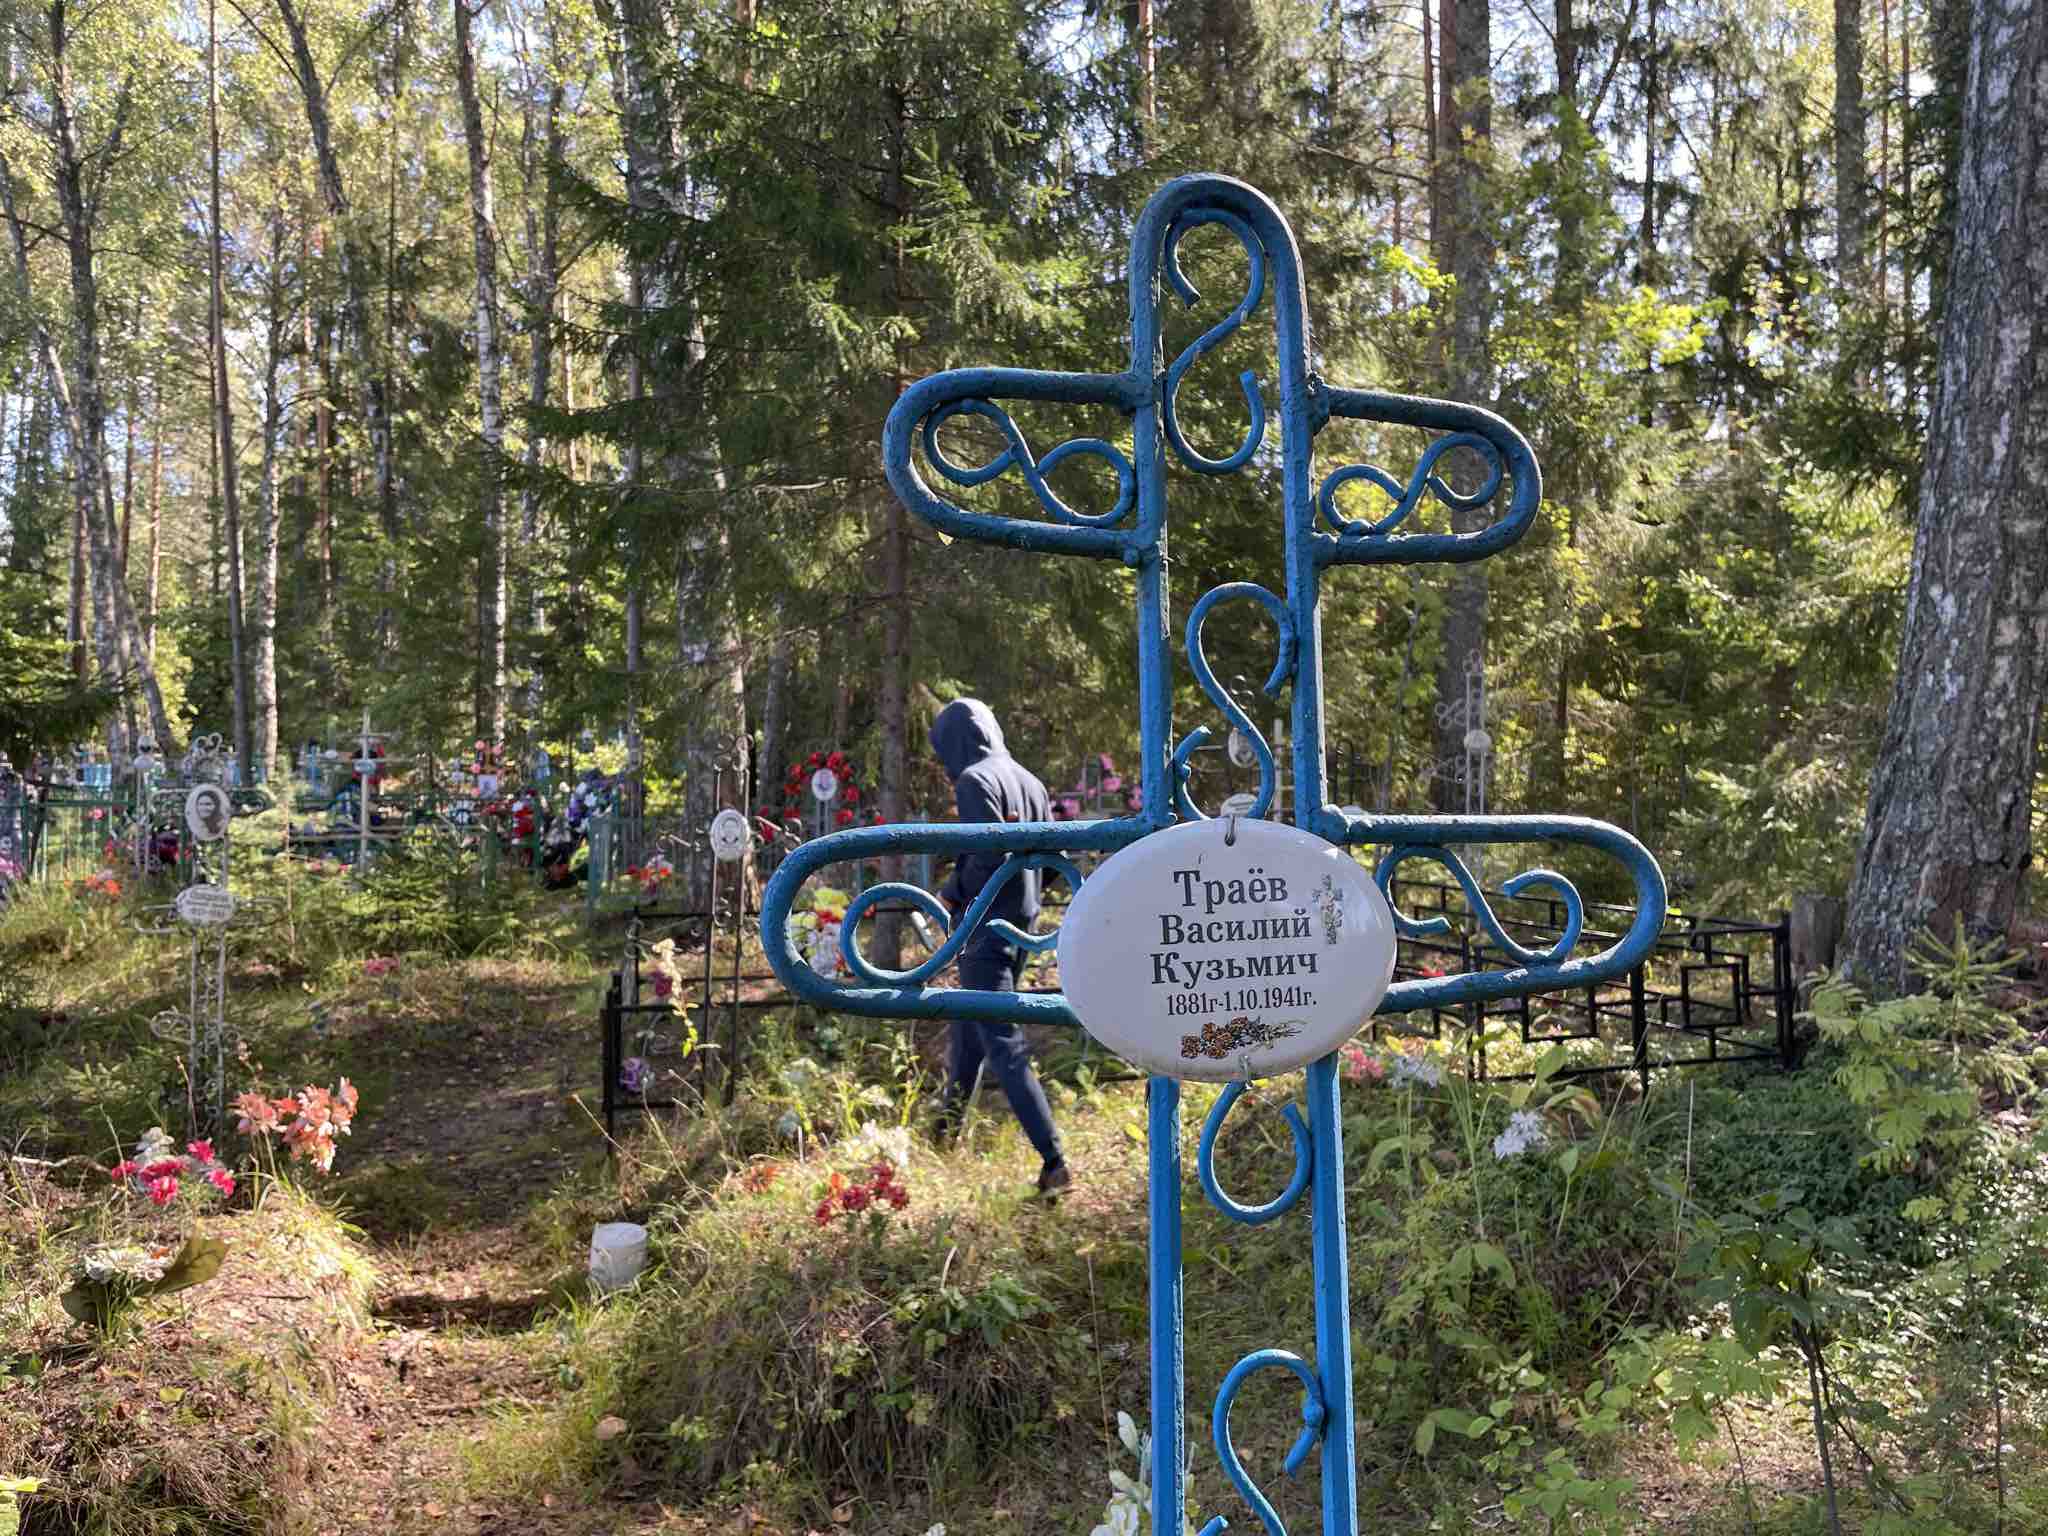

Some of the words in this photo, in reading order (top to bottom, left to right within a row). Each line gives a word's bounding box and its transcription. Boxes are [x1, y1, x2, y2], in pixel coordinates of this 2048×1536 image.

[1173, 868, 1288, 913] Траёв
[1159, 908, 1312, 945] Василий
[1150, 953, 1319, 989] Кузьмич
[1167, 986, 1317, 1015] 1881г-1.10.1941г.
